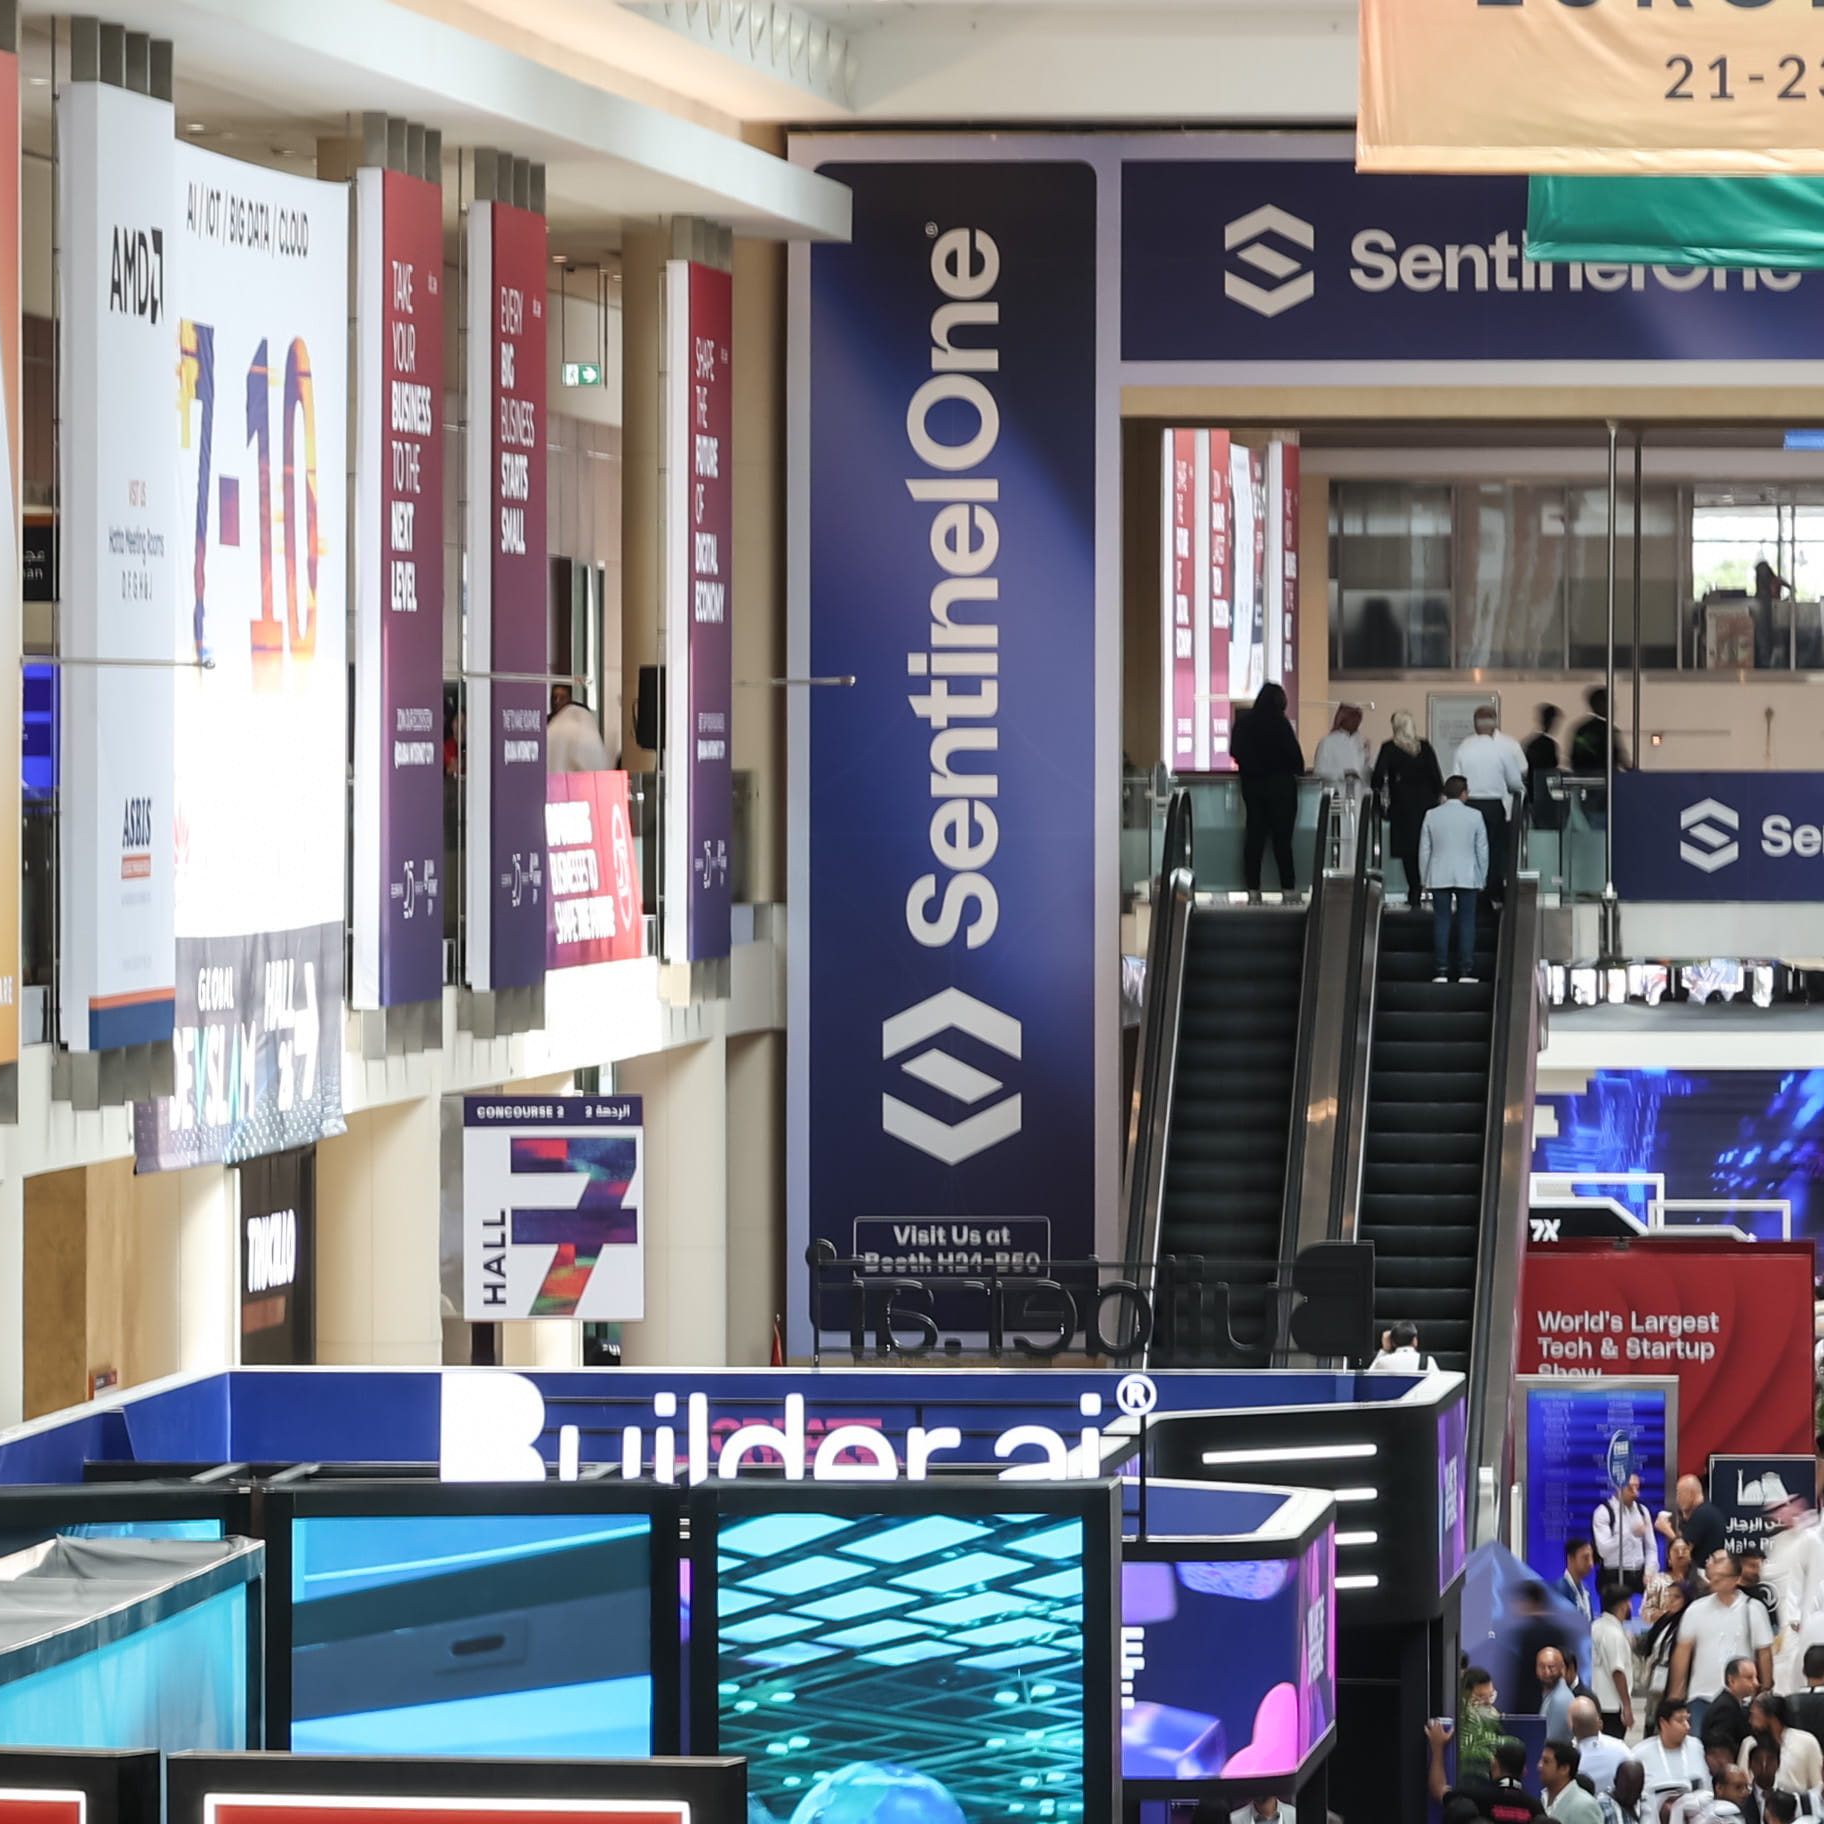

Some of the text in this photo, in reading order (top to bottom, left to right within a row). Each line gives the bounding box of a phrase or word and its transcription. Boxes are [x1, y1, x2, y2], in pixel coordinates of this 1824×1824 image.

[229, 199, 309, 259] BIG DATA CLOUD
[392, 259, 413, 315] TAKE
[501, 285, 523, 336] EVERY
[392, 321, 416, 374] YOUR
[392, 380, 432, 437] BUSINESS
[501, 397, 535, 448] BUSINESS
[501, 452, 529, 502] STARTS
[392, 502, 415, 552] NEXT
[392, 561, 418, 613] LEVEL
[122, 797, 152, 849] ASBIS
[476, 1104, 553, 1120] CONCOURSE
[510, 1136, 638, 1315] 7
[893, 1224, 1010, 1248] Visit Us at
[1529, 1218, 1561, 1242] 7X
[482, 1209, 507, 1307] HALL
[1536, 1310, 1720, 1338] World's Largest
[1536, 1337, 1715, 1363] Tech & Startup
